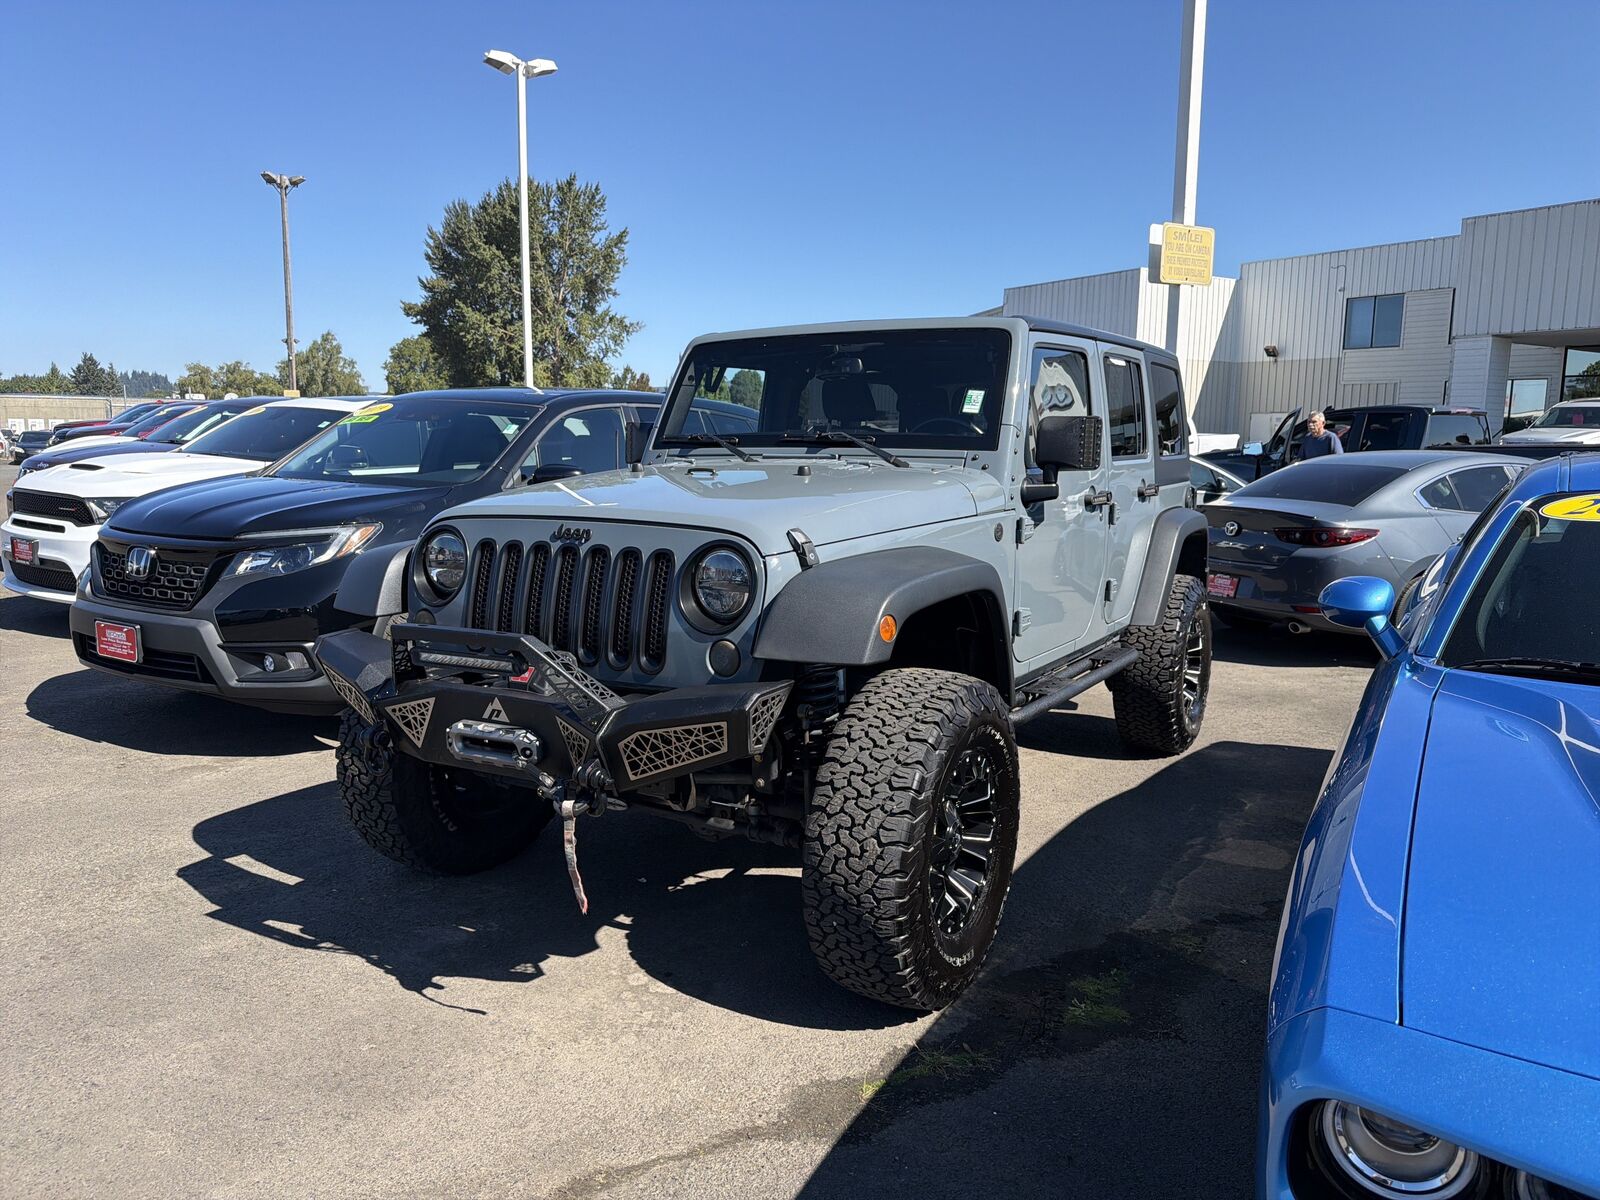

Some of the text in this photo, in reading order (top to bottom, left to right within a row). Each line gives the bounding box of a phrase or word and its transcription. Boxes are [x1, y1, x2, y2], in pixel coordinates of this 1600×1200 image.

[1173, 231, 1203, 243] SMILE!
[1165, 241, 1210, 256] YOU ARE ON CAMERA
[1561, 498, 1600, 515] 2
[550, 523, 592, 544] Jeep
